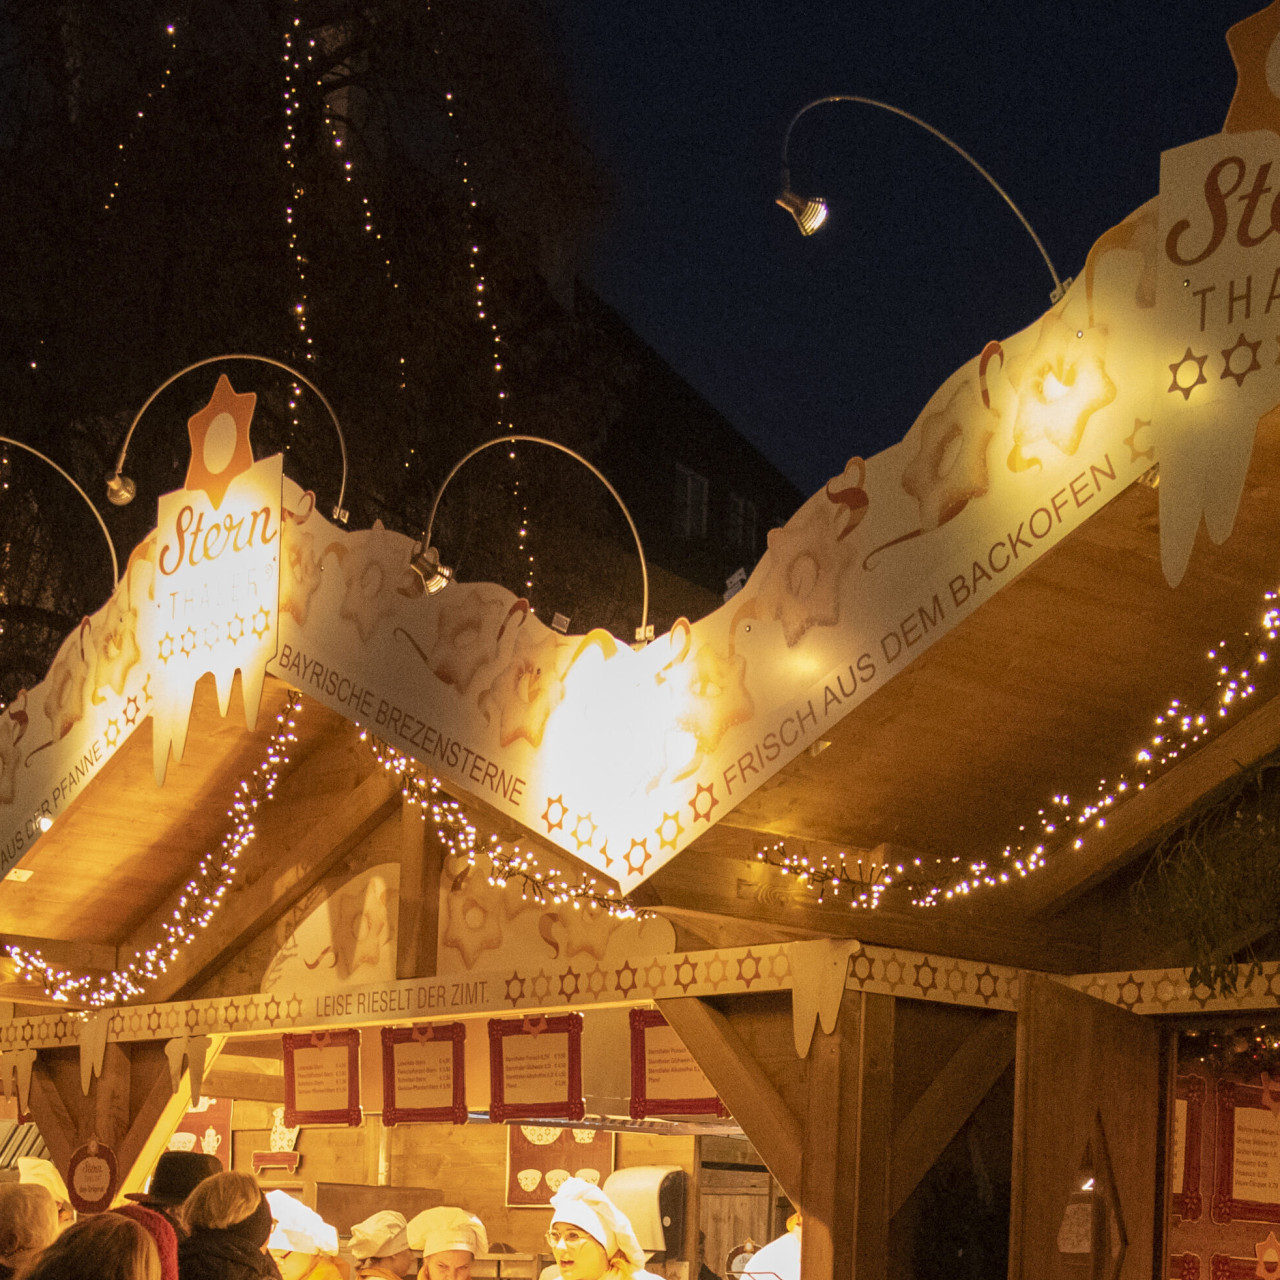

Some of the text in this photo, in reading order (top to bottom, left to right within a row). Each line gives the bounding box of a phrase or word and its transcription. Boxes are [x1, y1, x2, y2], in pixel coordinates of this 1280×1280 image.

[1165, 156, 1280, 266] St
[159, 505, 278, 576] Stern
[169, 568, 259, 620] THAER
[722, 454, 1117, 796] FRISCH AUS DEM BACKOFEN
[279, 644, 526, 806] BAYRISCHE BREZENSTERNE
[1, 831, 24, 866] AUS
[25, 800, 53, 840] DER
[52, 740, 103, 808] PFANNE
[316, 981, 489, 1018] LEISE RIESELT DER ZIMT.
